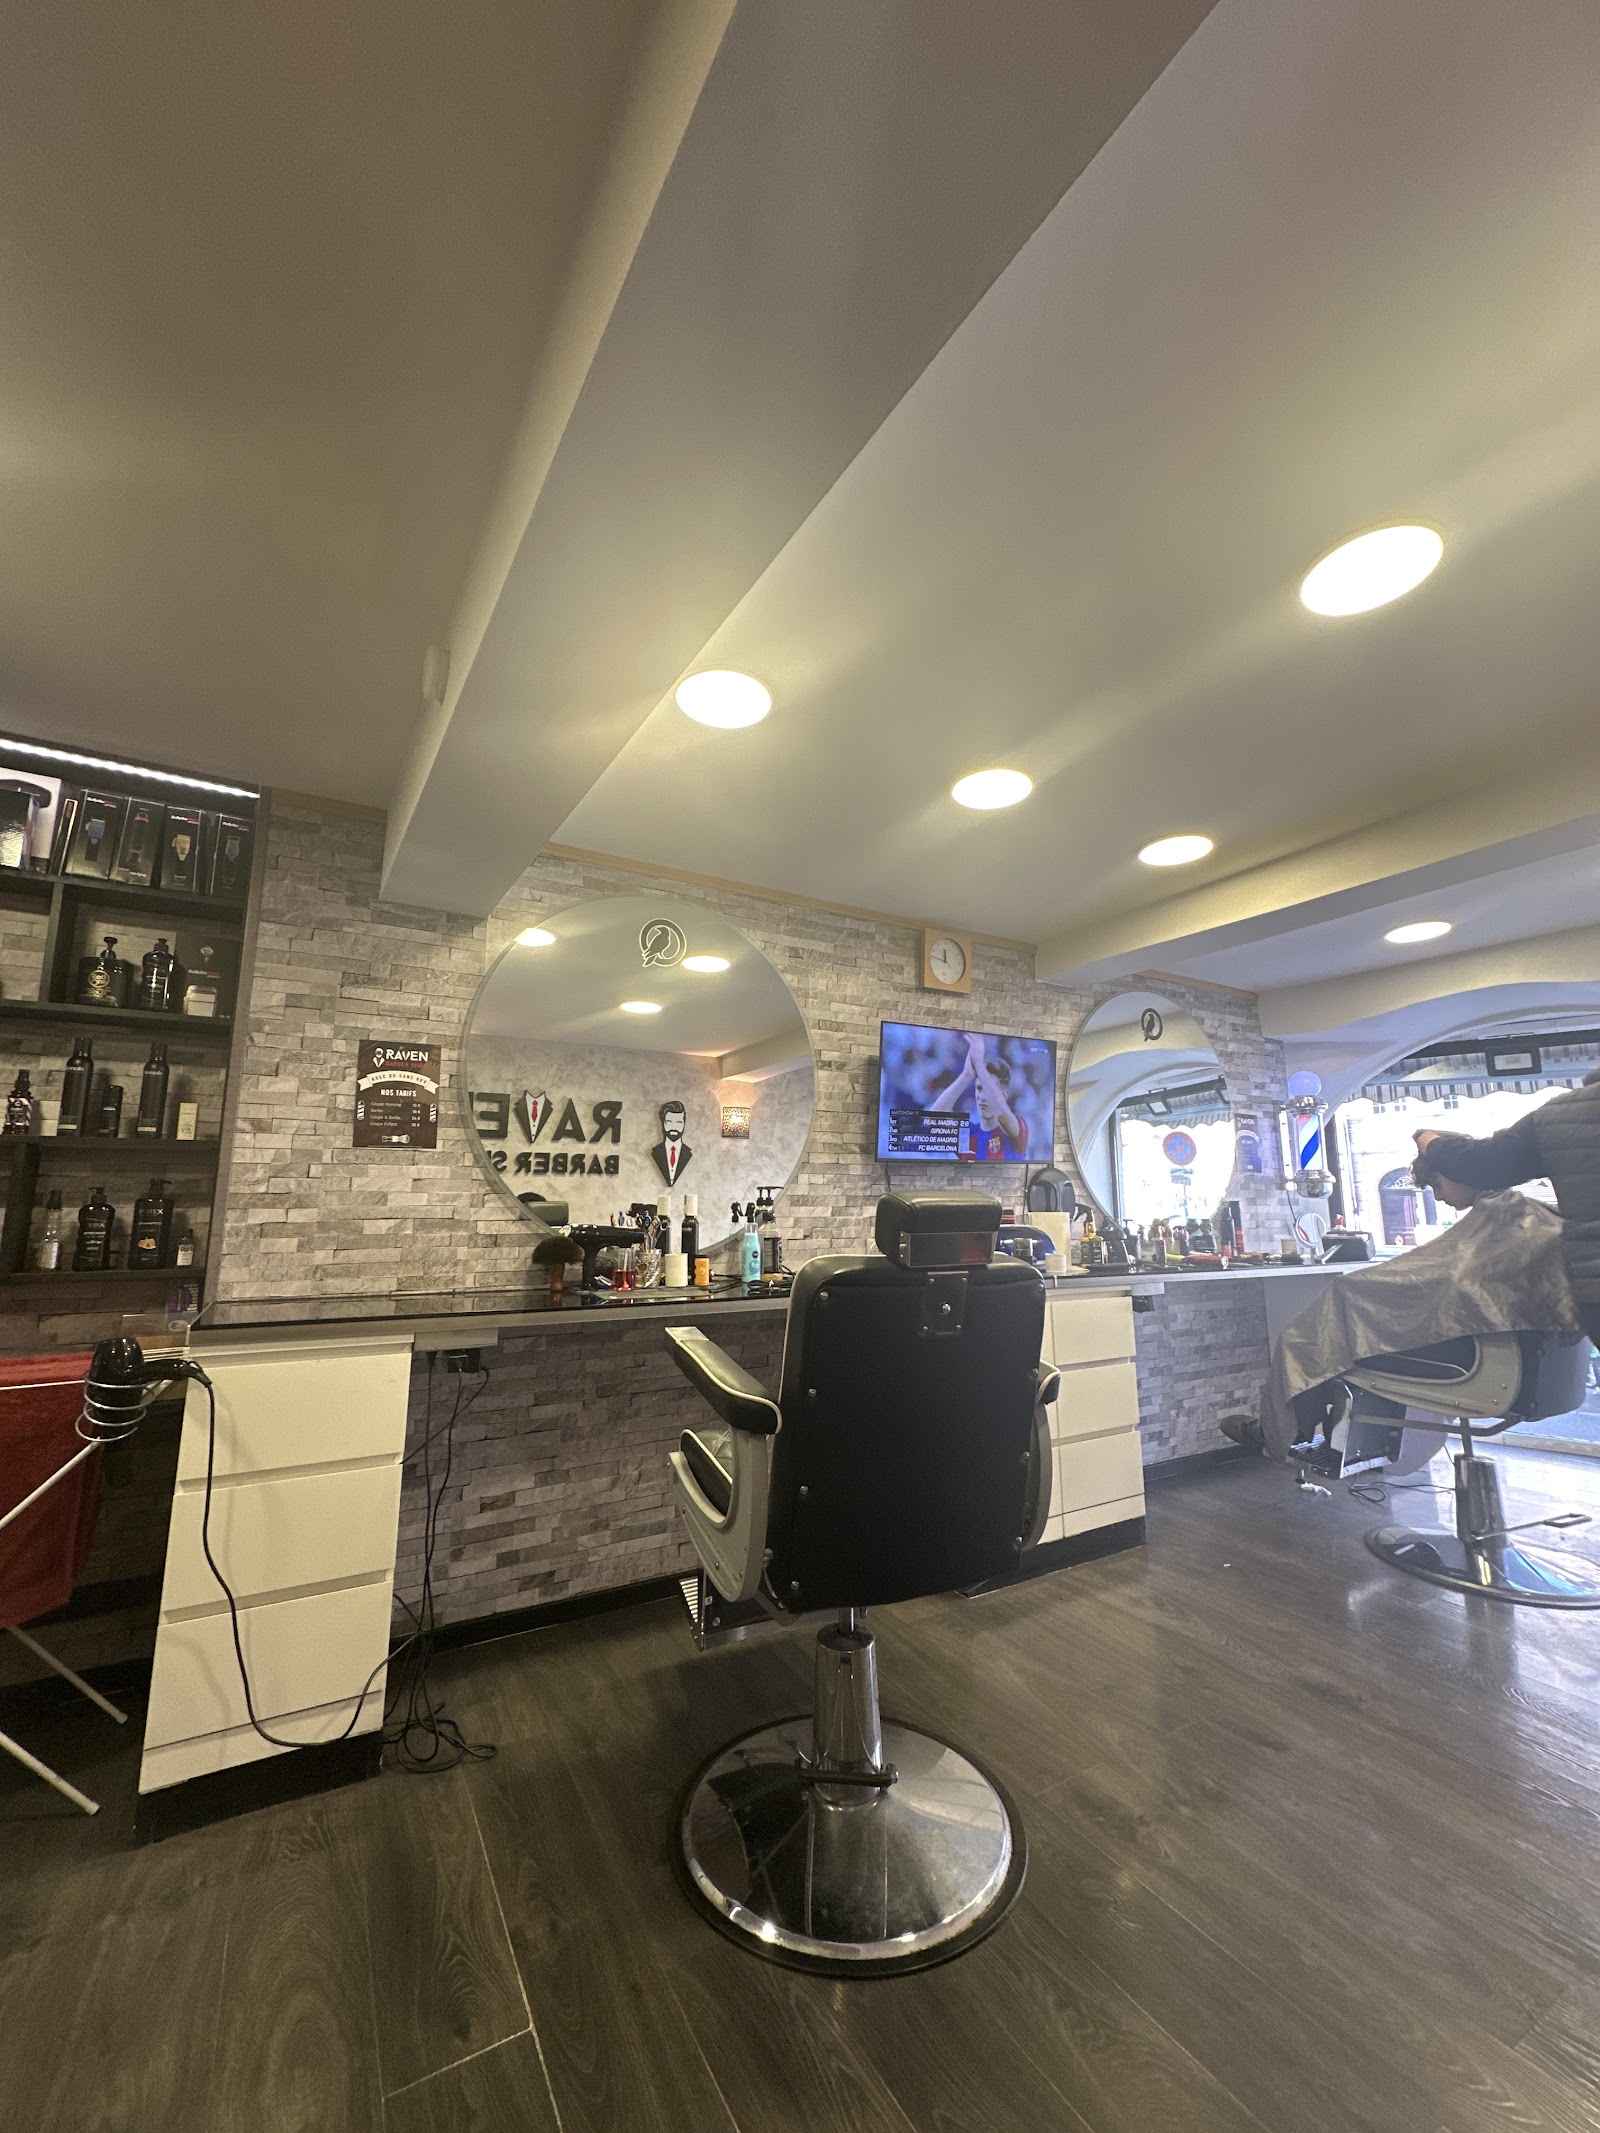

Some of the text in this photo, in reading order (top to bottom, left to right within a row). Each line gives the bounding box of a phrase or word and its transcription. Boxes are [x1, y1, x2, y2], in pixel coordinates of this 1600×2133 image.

[386, 1049, 429, 1062] RAVEN
[380, 1088, 417, 1097] NOS TARIFS
[923, 1118, 937, 1126] REAL
[937, 1119, 958, 1127] MADRID
[903, 1134, 929, 1142] ATLÉTICO
